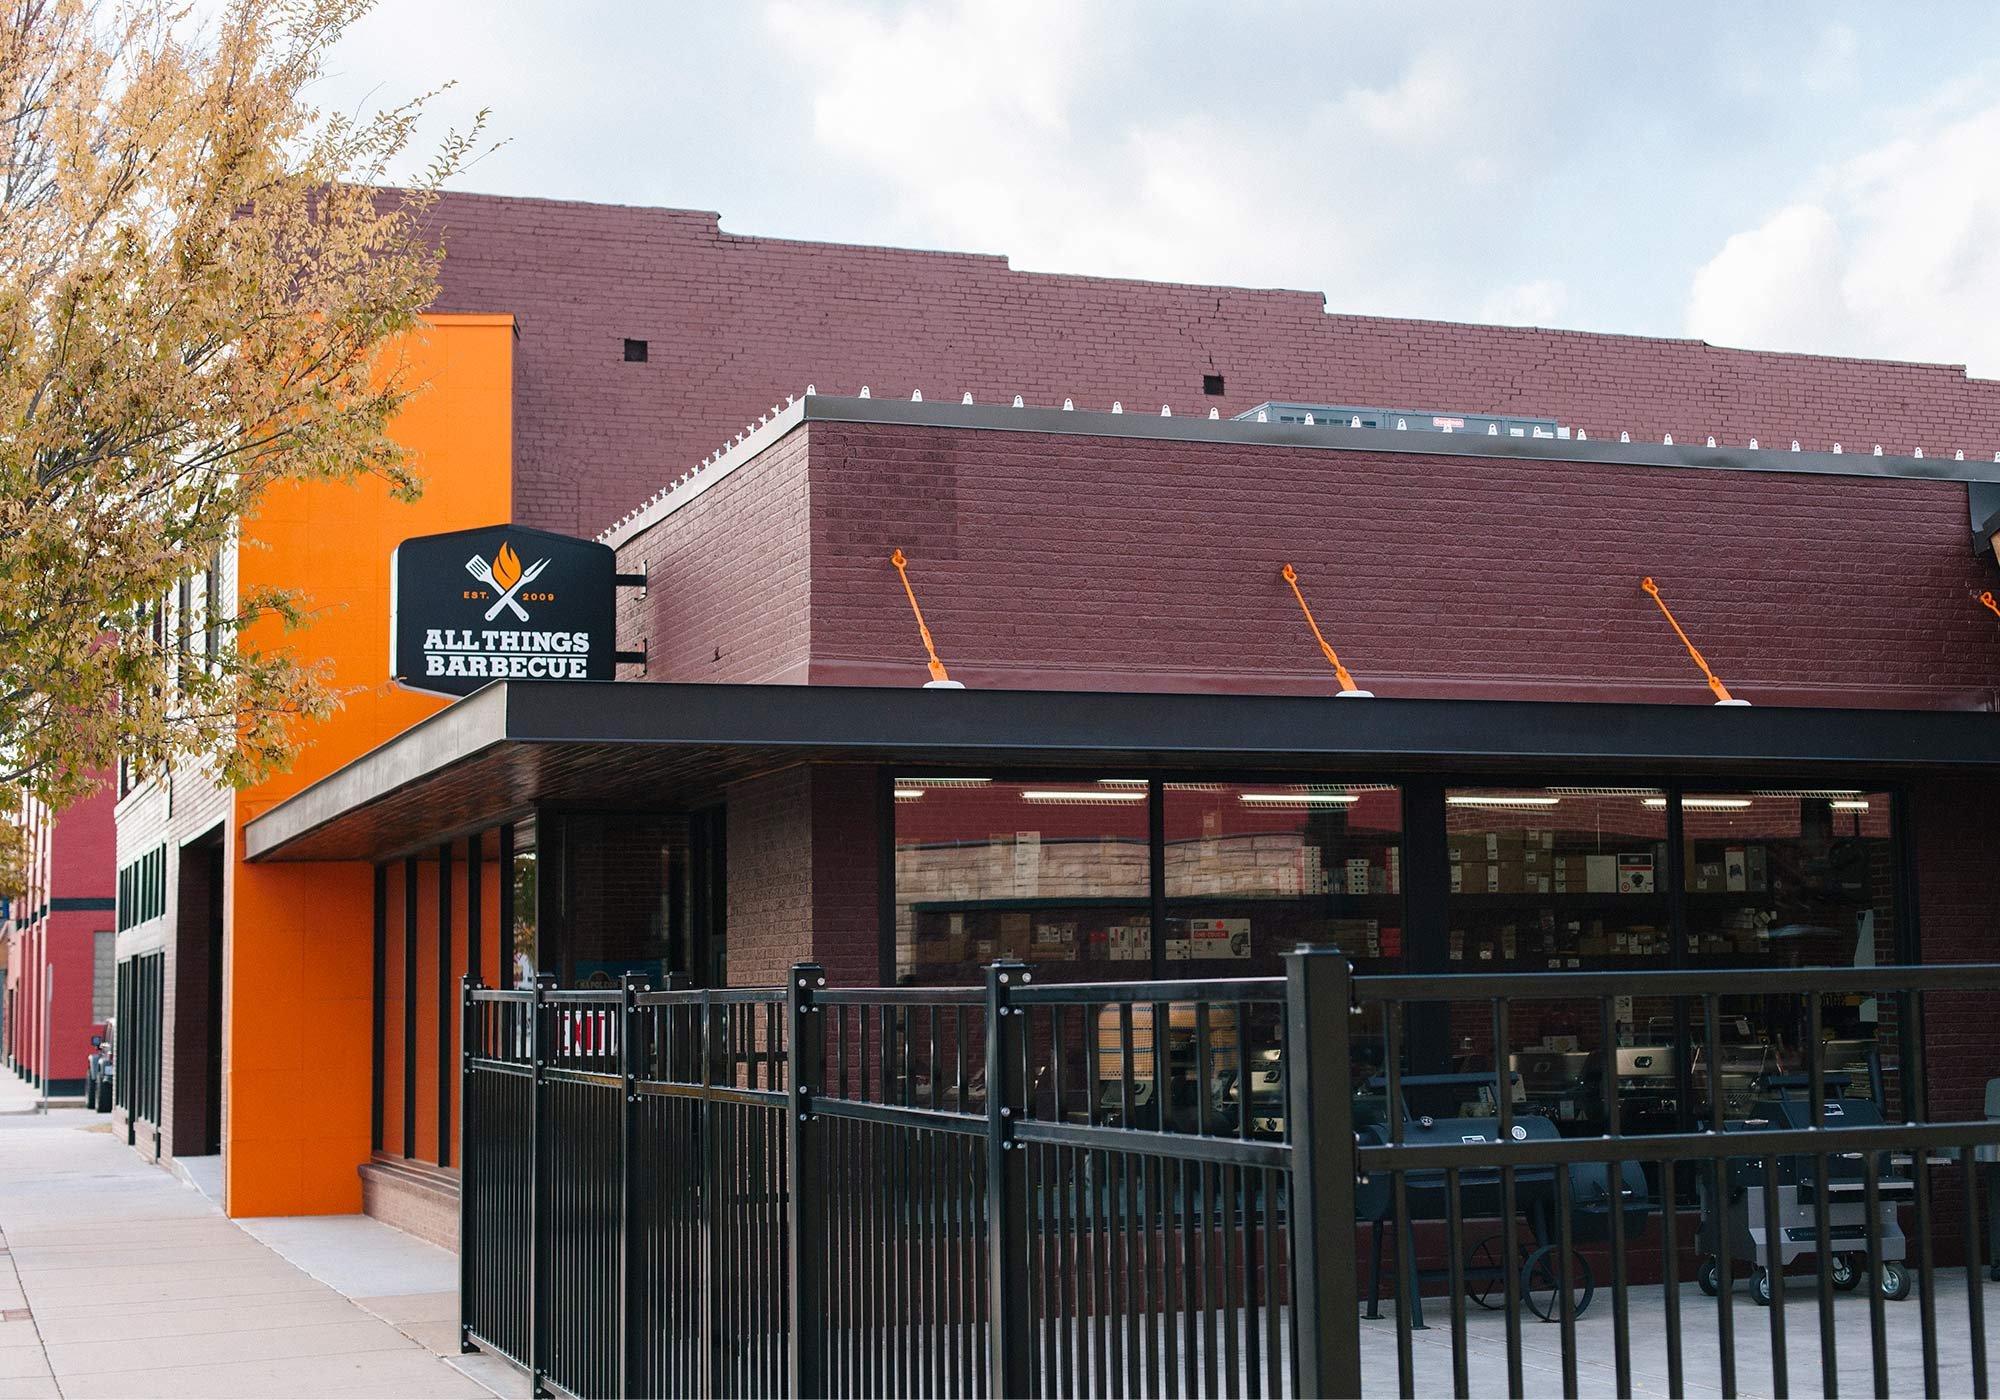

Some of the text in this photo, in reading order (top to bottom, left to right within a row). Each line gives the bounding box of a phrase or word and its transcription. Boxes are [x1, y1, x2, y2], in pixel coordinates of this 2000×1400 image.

[463, 591, 555, 601] EST. 2009
[423, 629, 590, 653] ALL THINGS
[426, 655, 587, 678] BARBECUE
